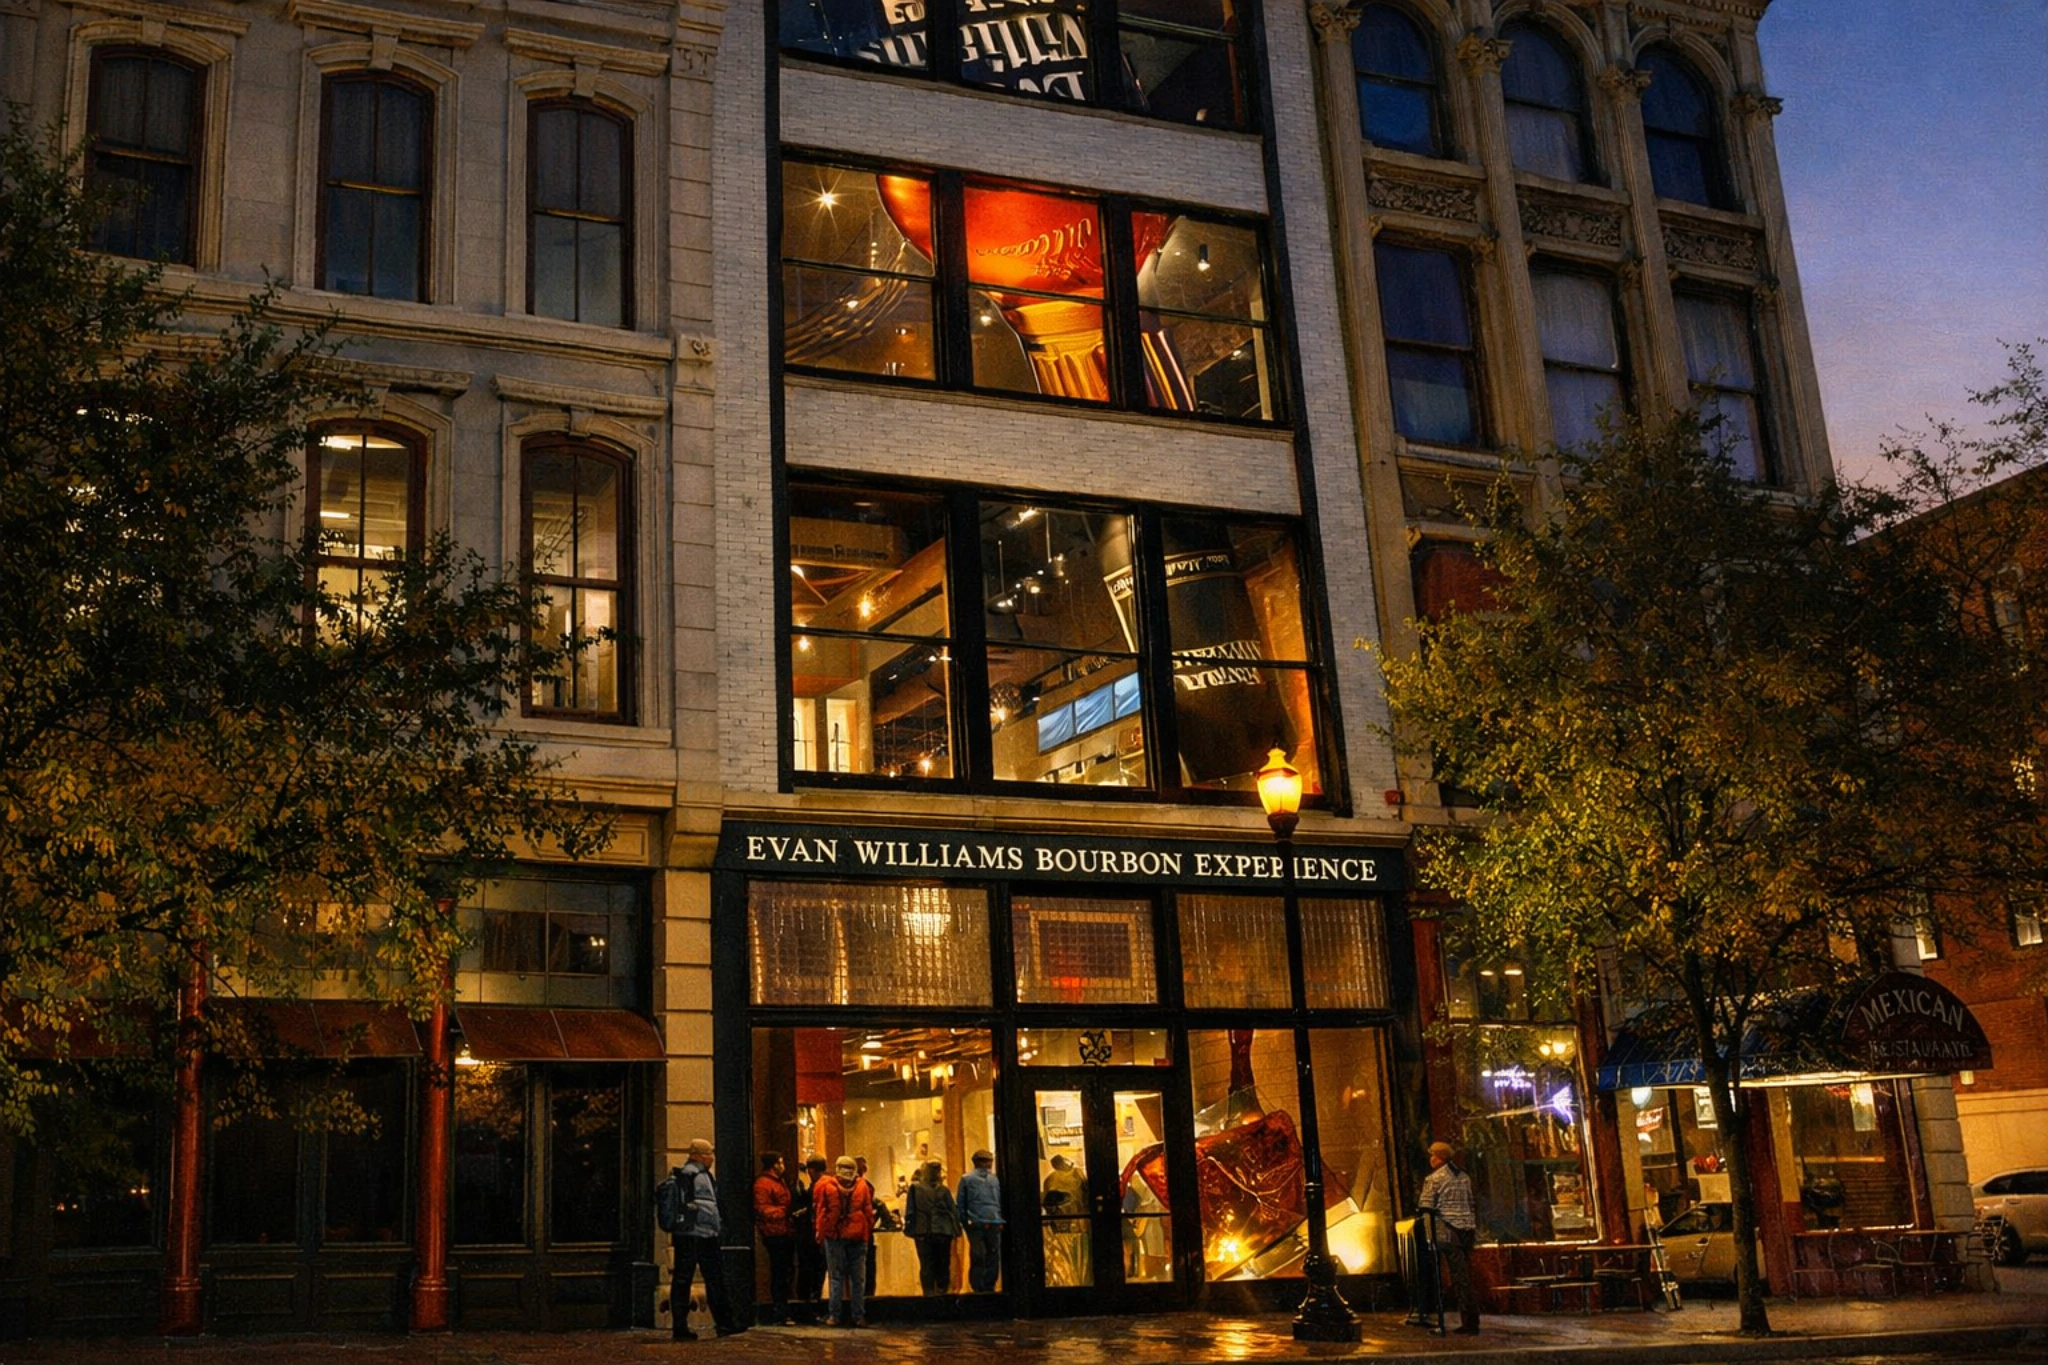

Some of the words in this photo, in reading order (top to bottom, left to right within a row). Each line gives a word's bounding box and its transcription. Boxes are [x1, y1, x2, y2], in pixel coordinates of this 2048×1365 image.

[747, 836, 837, 863] EVAN
[854, 840, 1023, 870] WILLIAMS
[1034, 847, 1182, 875] BOURBON
[1860, 989, 1964, 1032] MEXICAN
